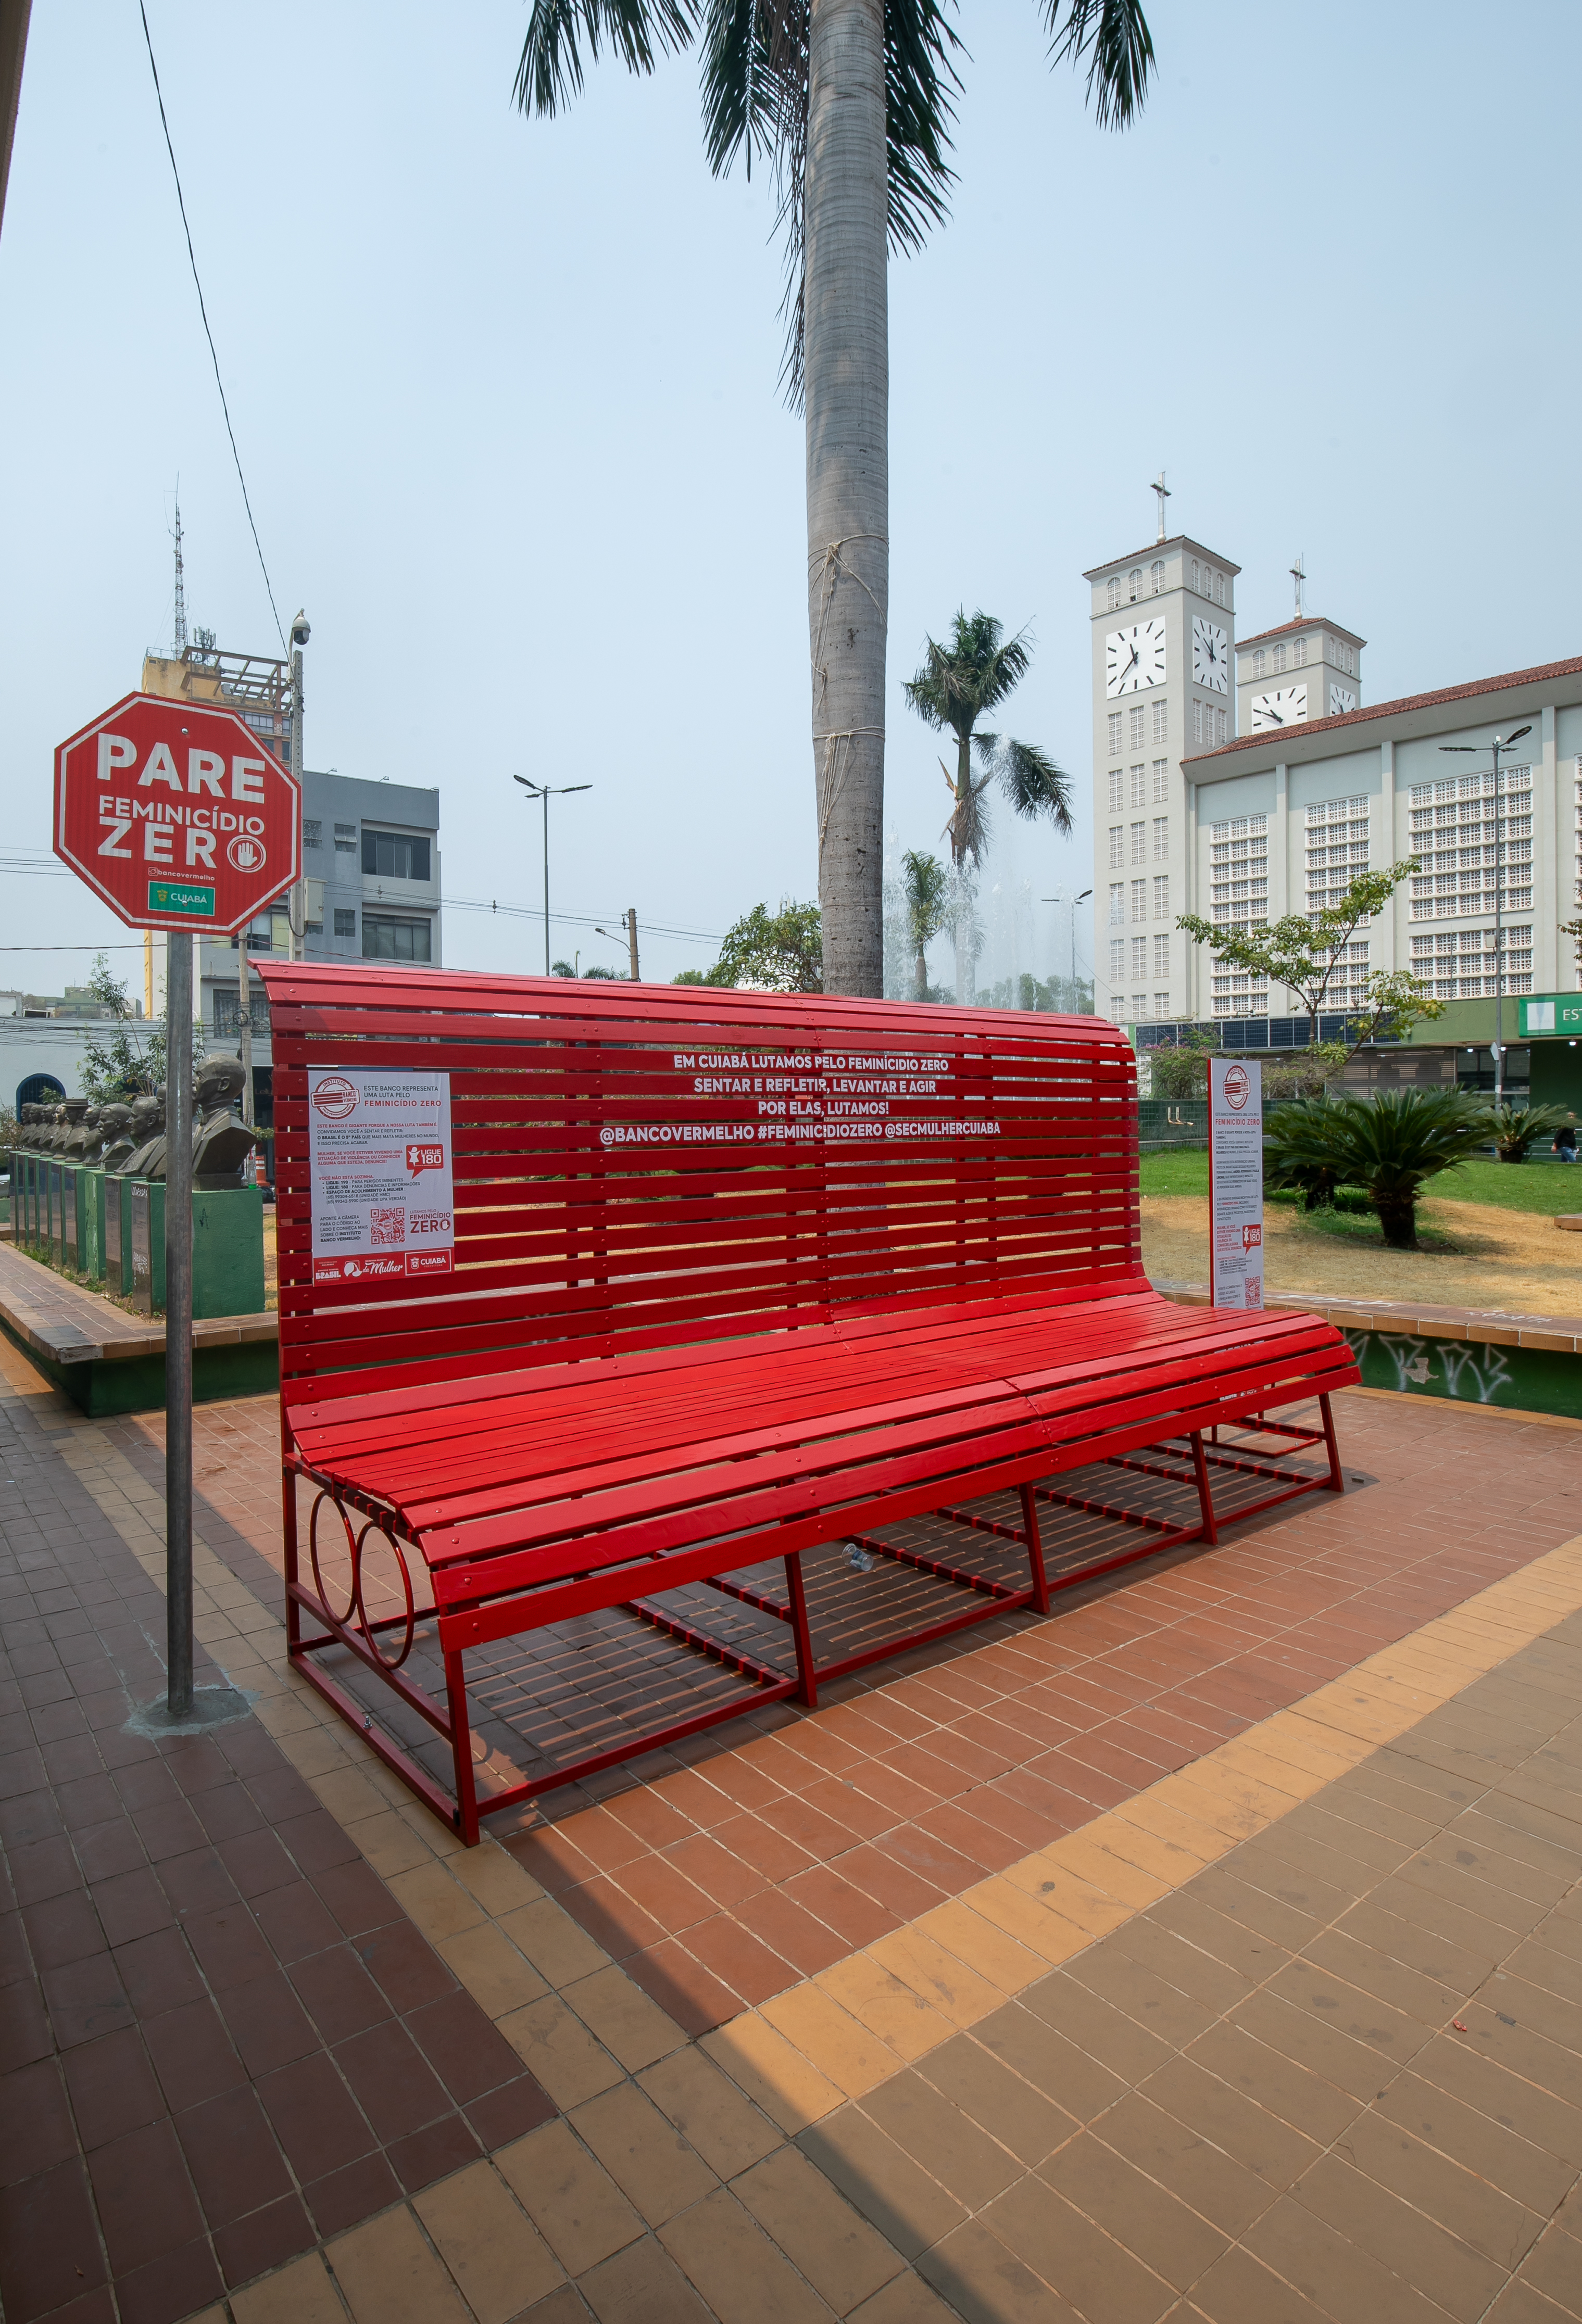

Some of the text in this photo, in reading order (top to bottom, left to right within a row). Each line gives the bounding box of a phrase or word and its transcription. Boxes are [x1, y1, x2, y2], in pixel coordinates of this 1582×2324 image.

[97, 732, 266, 804] PARE
[99, 794, 265, 836] FEMINICÍDIO
[170, 893, 207, 904] CUIABÁ
[673, 1054, 695, 1068] EM
[698, 1052, 749, 1069] CUIABÁ
[751, 1055, 812, 1069] LUTAMOS
[815, 1056, 846, 1069] PELO
[920, 1059, 949, 1071] ZERO
[694, 1078, 936, 1093] SENTAR E REFLETIR, LEVANTAR E AGIR
[365, 1098, 417, 1107] FEMINICÍDIO
[758, 1101, 889, 1117] POR ELAS, LUTAMOS!
[1215, 1117, 1246, 1125] FEMINICÍDIO
[599, 1125, 755, 1145] @BANCOVERMELHO
[885, 1121, 1000, 1139] @SECMULHERCUIABA
[421, 1154, 442, 1164] 180
[409, 1211, 451, 1220] FEMINICÍDIO
[1249, 1233, 1260, 1242] 180
[420, 1255, 446, 1266] CUIABÁ
[365, 1260, 403, 1274] Mulher
[315, 1270, 342, 1280] BRASIL
